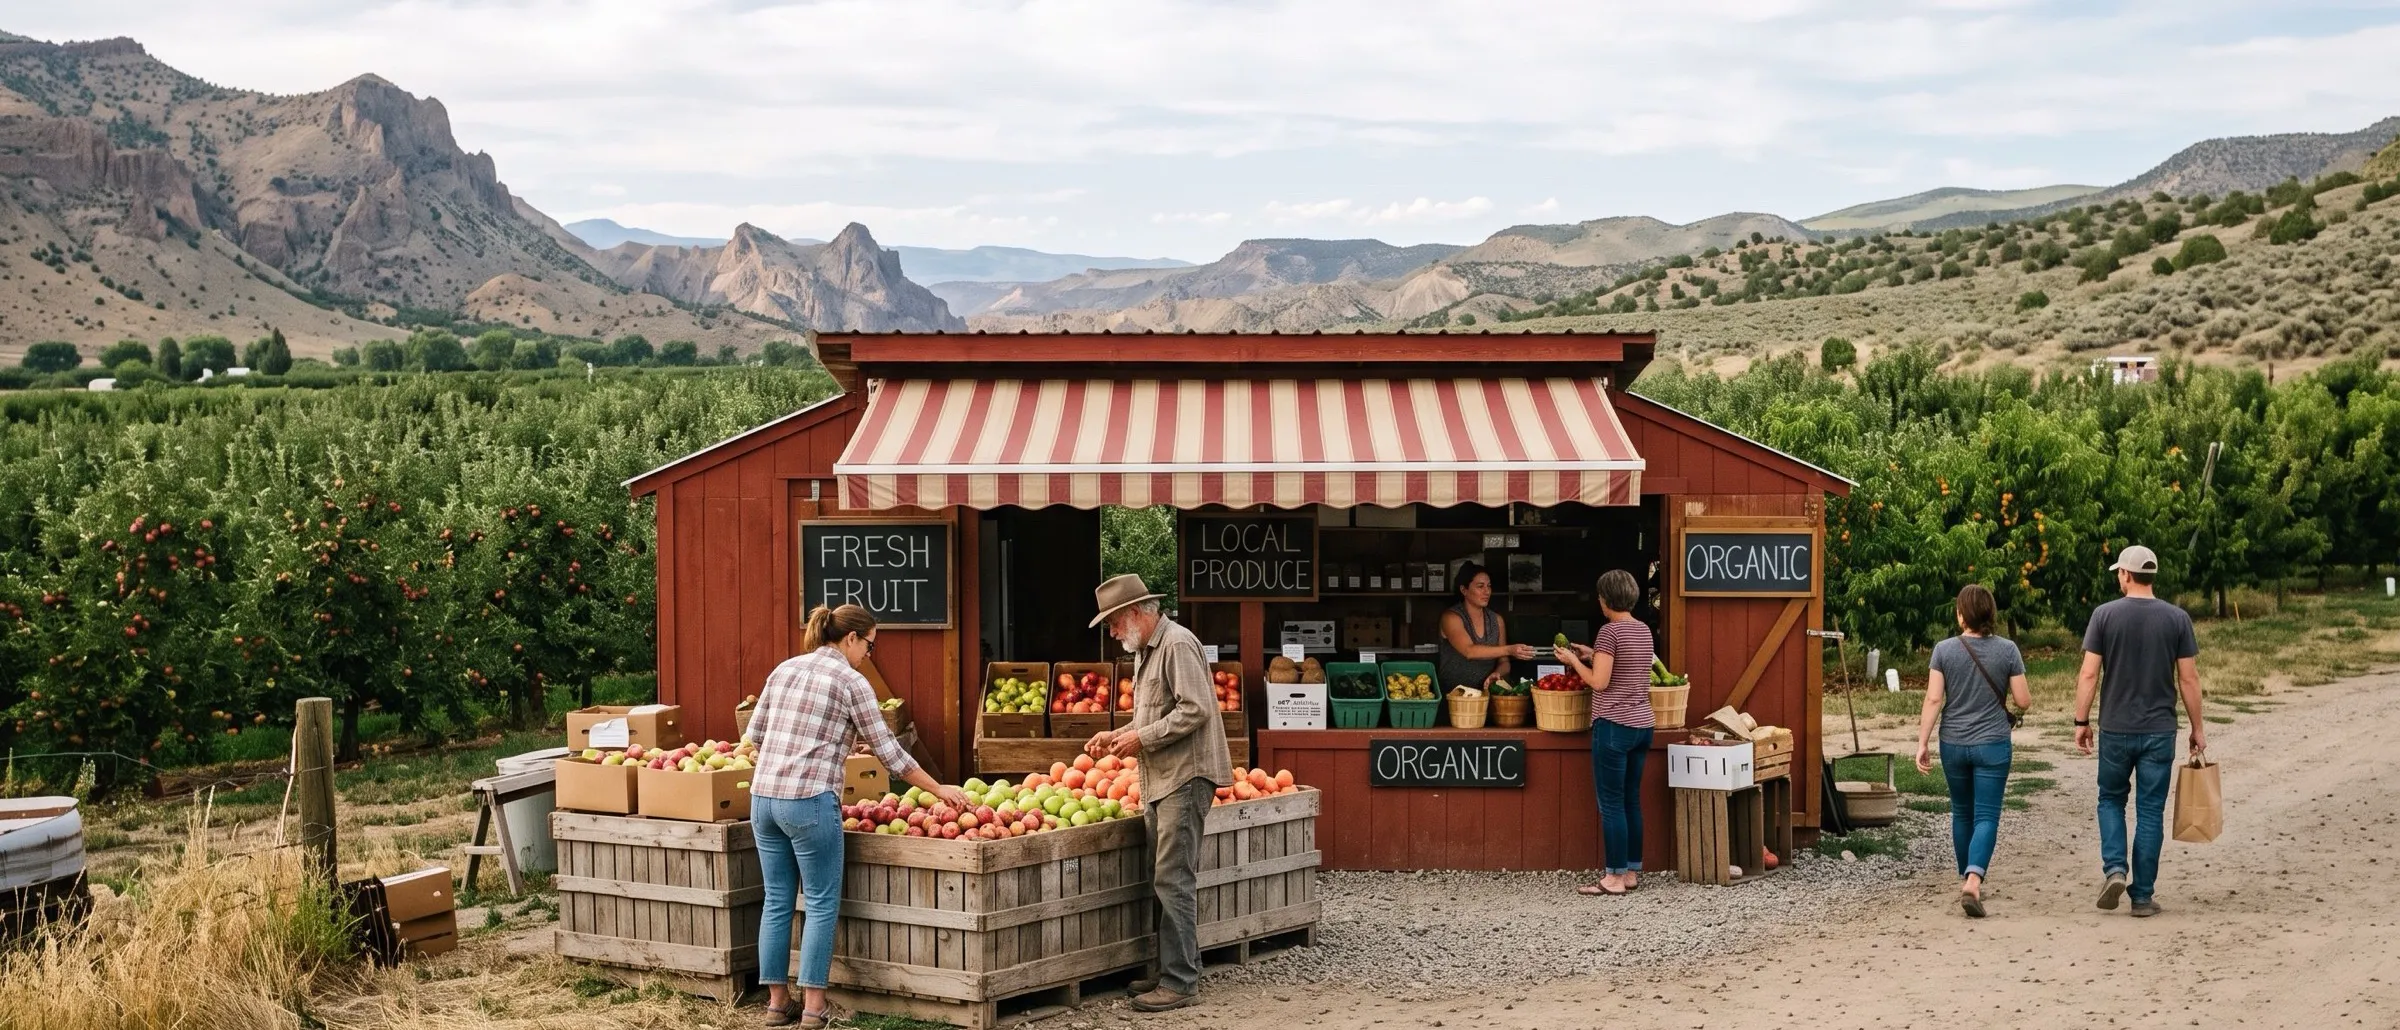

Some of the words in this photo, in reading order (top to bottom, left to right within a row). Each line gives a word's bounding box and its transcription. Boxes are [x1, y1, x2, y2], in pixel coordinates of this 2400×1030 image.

[821, 535, 929, 569] FRESH
[1202, 523, 1301, 553] LOCAL
[1191, 559, 1311, 590] PRODUCE
[1687, 544, 1808, 580] ORGANIC
[823, 578, 929, 612] FRUIT
[1377, 745, 1518, 780] ORGANIC
